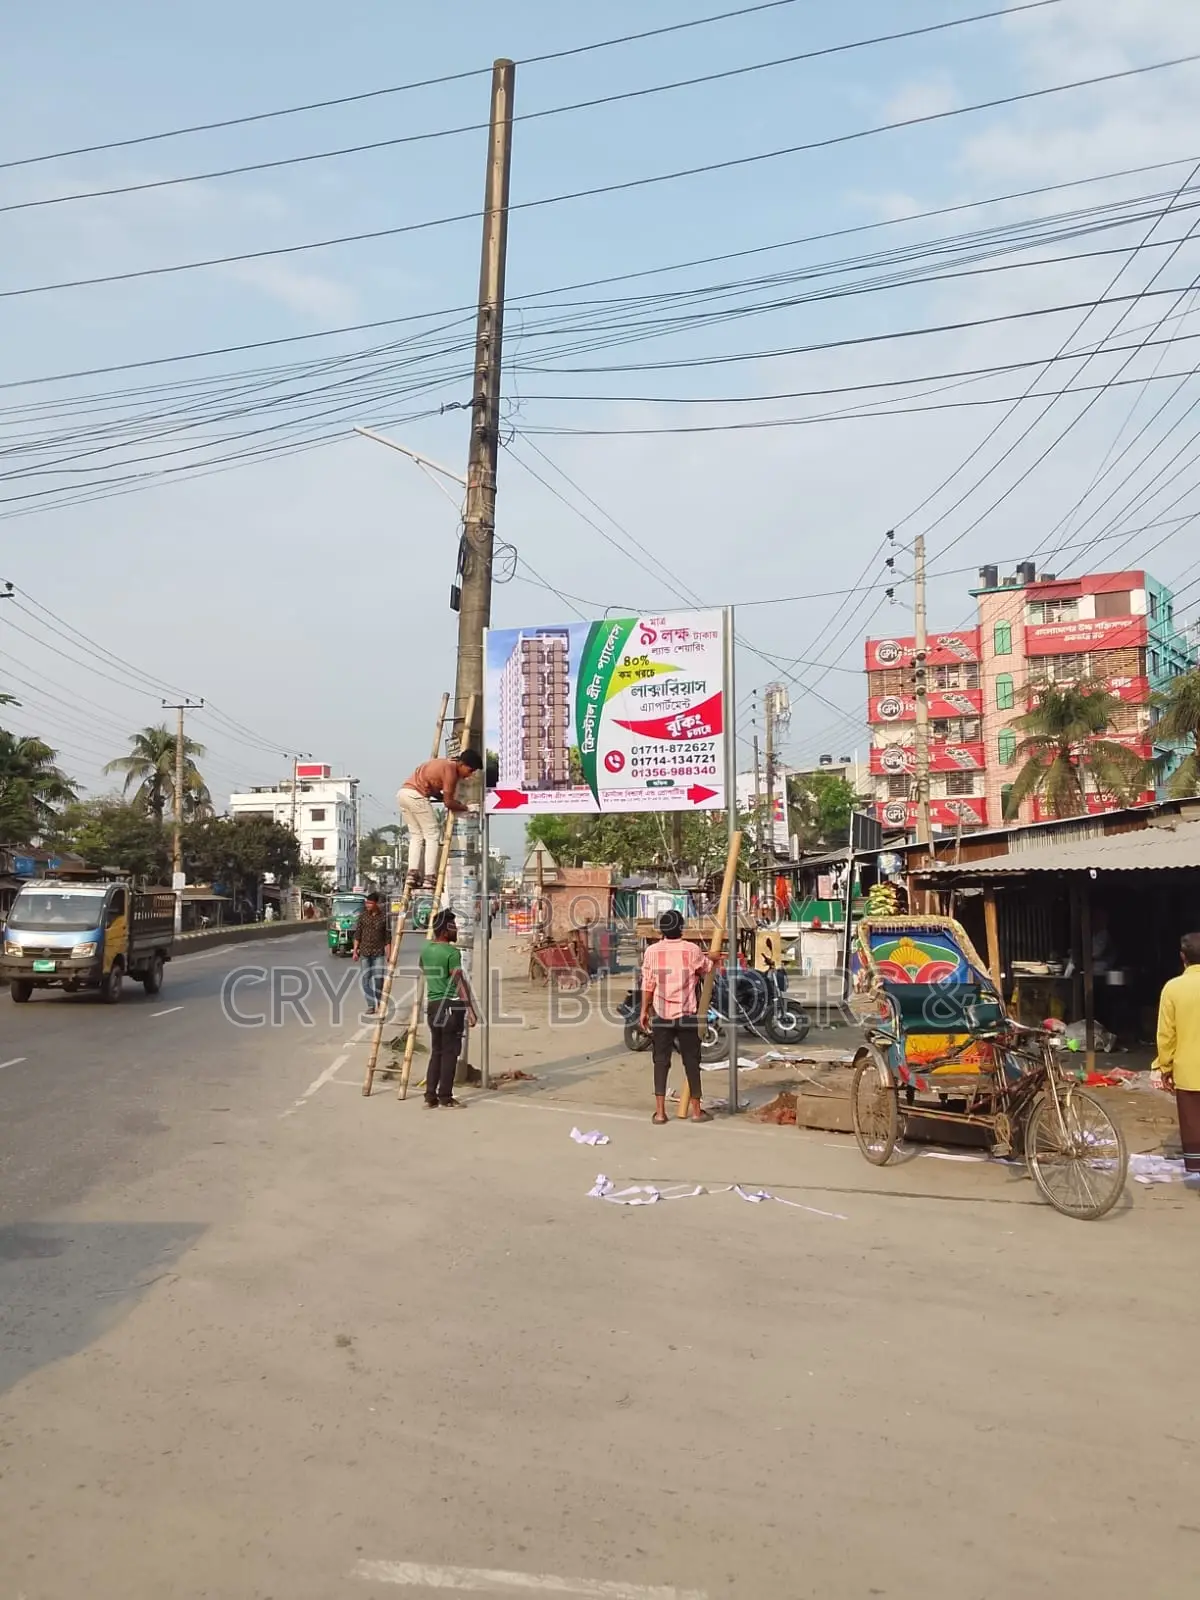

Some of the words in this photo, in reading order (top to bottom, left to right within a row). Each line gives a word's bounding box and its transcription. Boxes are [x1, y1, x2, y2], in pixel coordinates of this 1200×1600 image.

[639, 622, 658, 646] ৯
[660, 627, 690, 643] লক্ষ
[623, 654, 650, 667] ৪০%
[664, 713, 704, 737] বুকিং
[631, 742, 715, 755] 01711-872627
[631, 754, 716, 767] 01714-134721
[631, 766, 716, 777] 01356-988340
[887, 809, 905, 819] GPH
